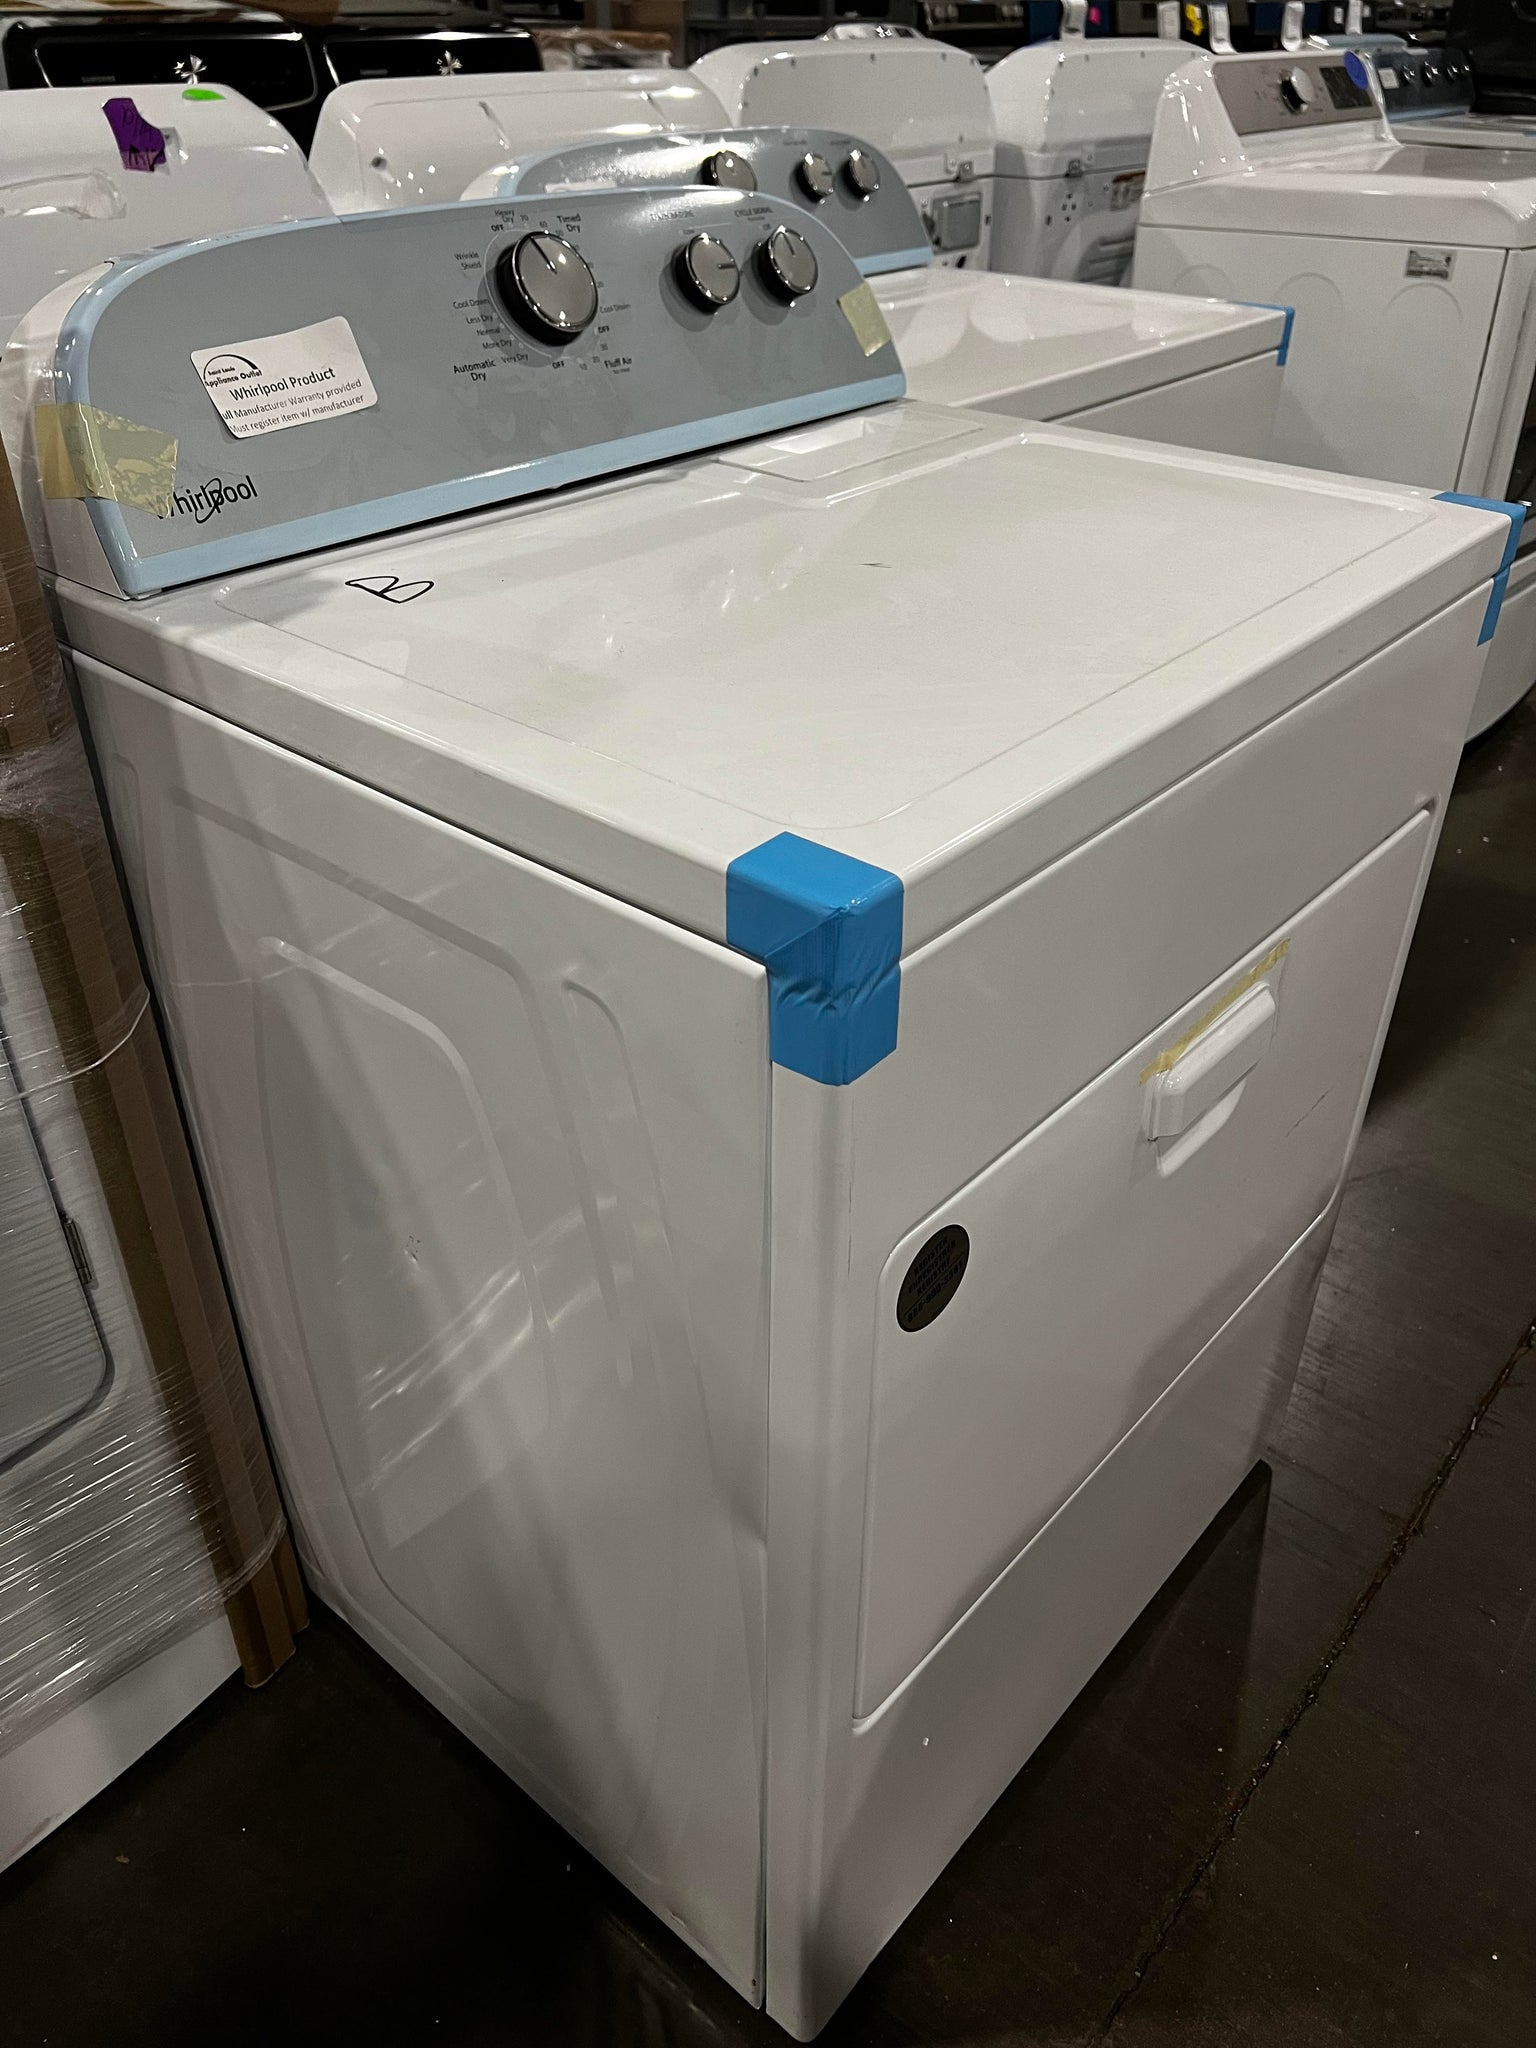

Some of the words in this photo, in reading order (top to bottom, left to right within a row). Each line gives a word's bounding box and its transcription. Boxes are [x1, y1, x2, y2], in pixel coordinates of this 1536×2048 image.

[556, 213, 582, 224] Timed
[566, 223, 581, 233] Dry
[453, 300, 471, 310] Cool
[471, 298, 490, 308] Down
[466, 315, 481, 325] Less
[480, 314, 494, 324] Dry
[477, 327, 500, 337] Normal
[482, 340, 499, 350] More
[499, 338, 513, 349] Dry
[501, 355, 517, 365] Very
[516, 353, 529, 363] Dry
[604, 358, 622, 369] Fluff
[453, 359, 497, 374] Automatic
[552, 361, 565, 370] OFF
[470, 371, 487, 383] Dry
[229, 378, 290, 402] Whirlpool
[290, 367, 337, 391] Product
[222, 410, 234, 420] ull
[233, 400, 288, 418] Manufacturer
[287, 391, 325, 406] Warranty
[325, 378, 362, 398] provided
[250, 414, 281, 431] register
[280, 412, 300, 424] item
[299, 408, 312, 419] w/
[312, 394, 365, 416] manufacturer
